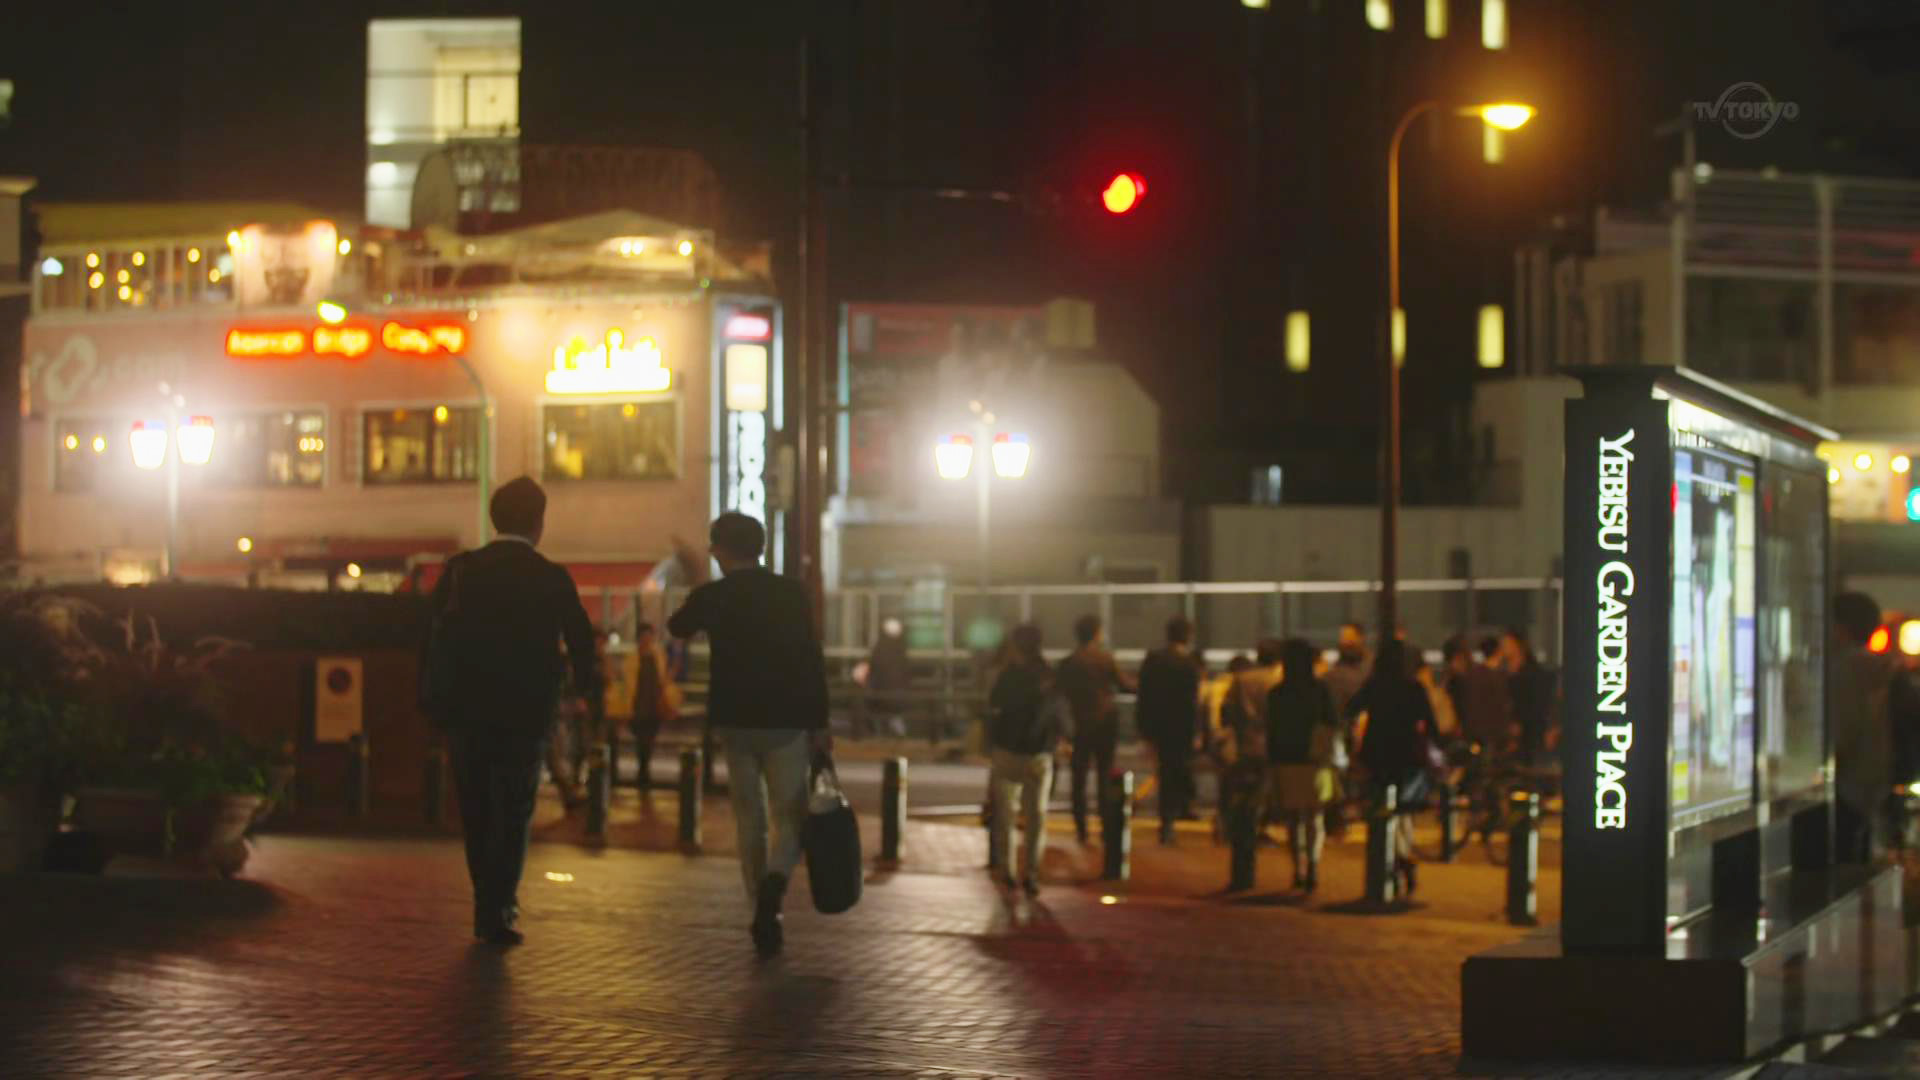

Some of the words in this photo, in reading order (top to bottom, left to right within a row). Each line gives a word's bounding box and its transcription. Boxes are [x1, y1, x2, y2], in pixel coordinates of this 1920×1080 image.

[1598, 428, 1635, 553] YEBISU
[1597, 560, 1635, 715] GARDEN
[1595, 721, 1633, 829] PLACE
